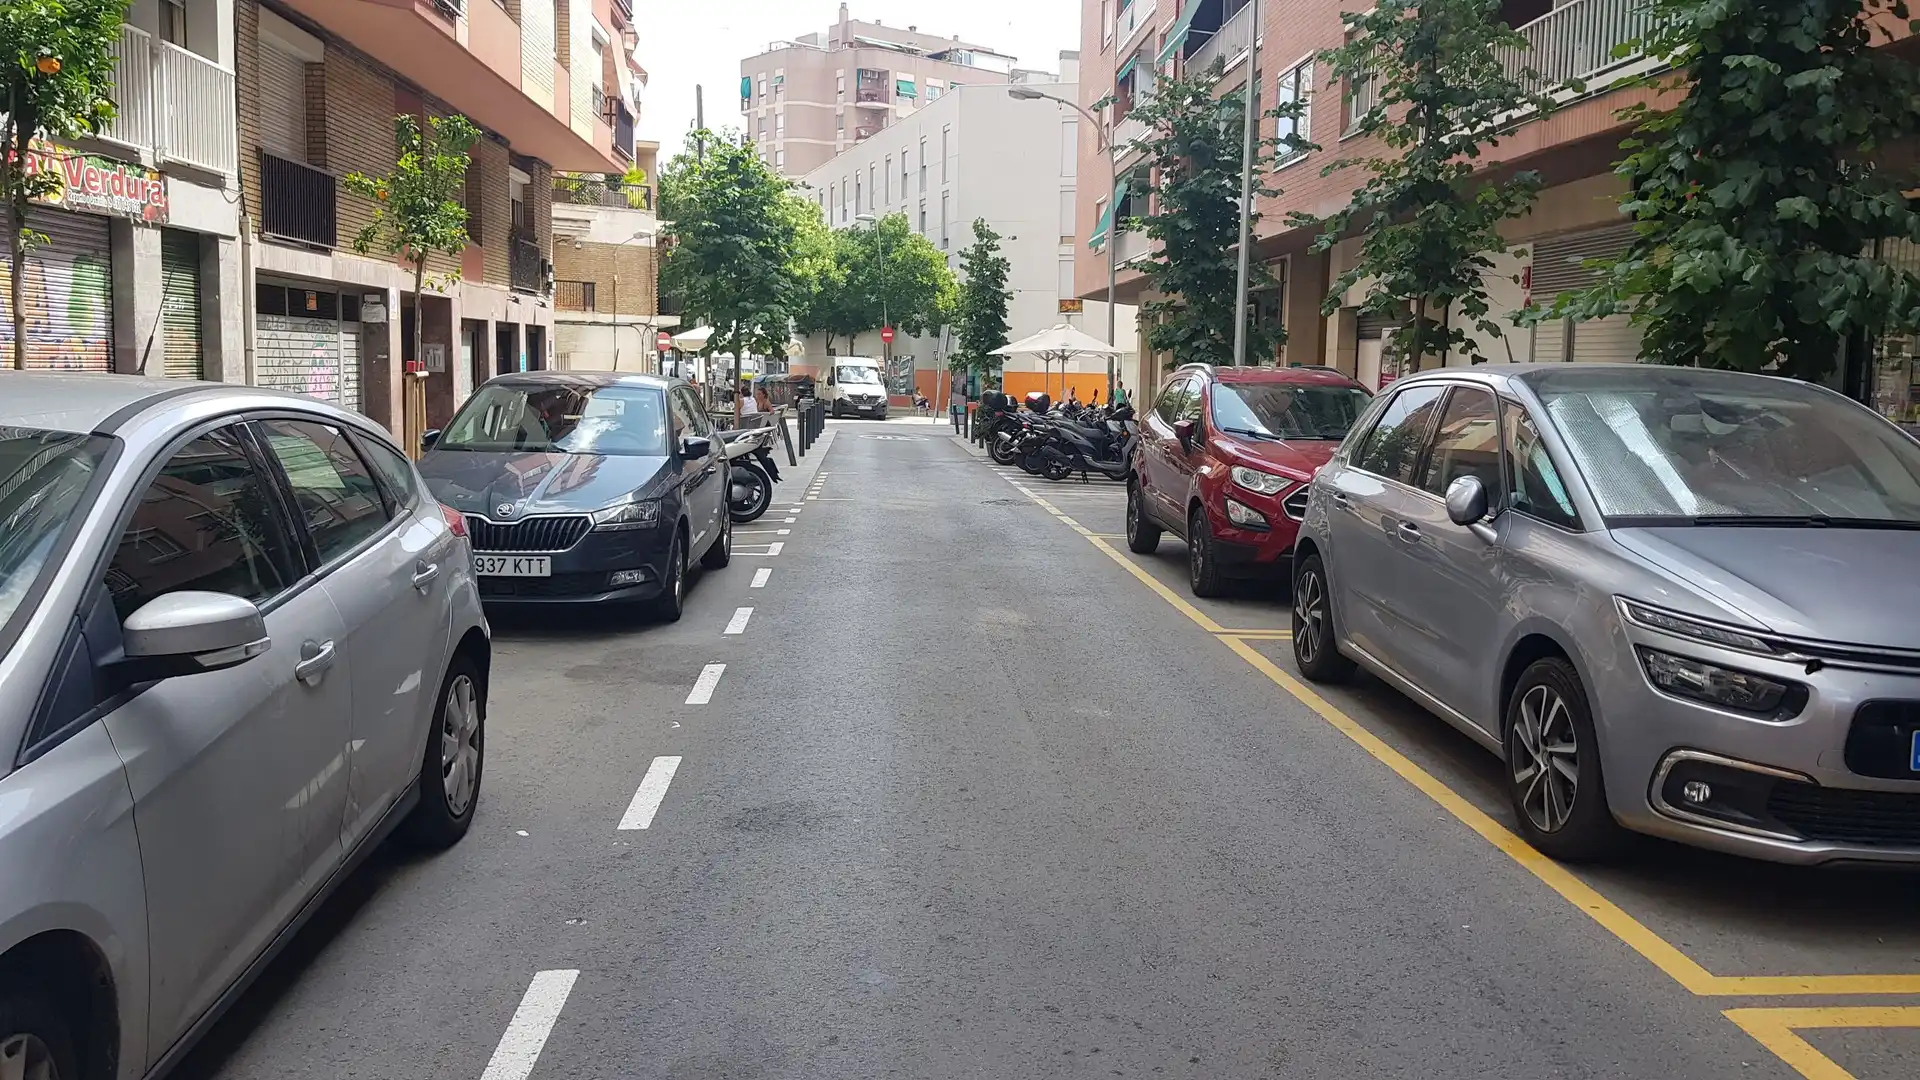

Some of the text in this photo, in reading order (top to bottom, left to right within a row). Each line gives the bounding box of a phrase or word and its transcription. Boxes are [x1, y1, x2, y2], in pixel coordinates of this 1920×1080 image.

[62, 153, 165, 207] Verdura
[474, 557, 546, 574] 937 KTT
